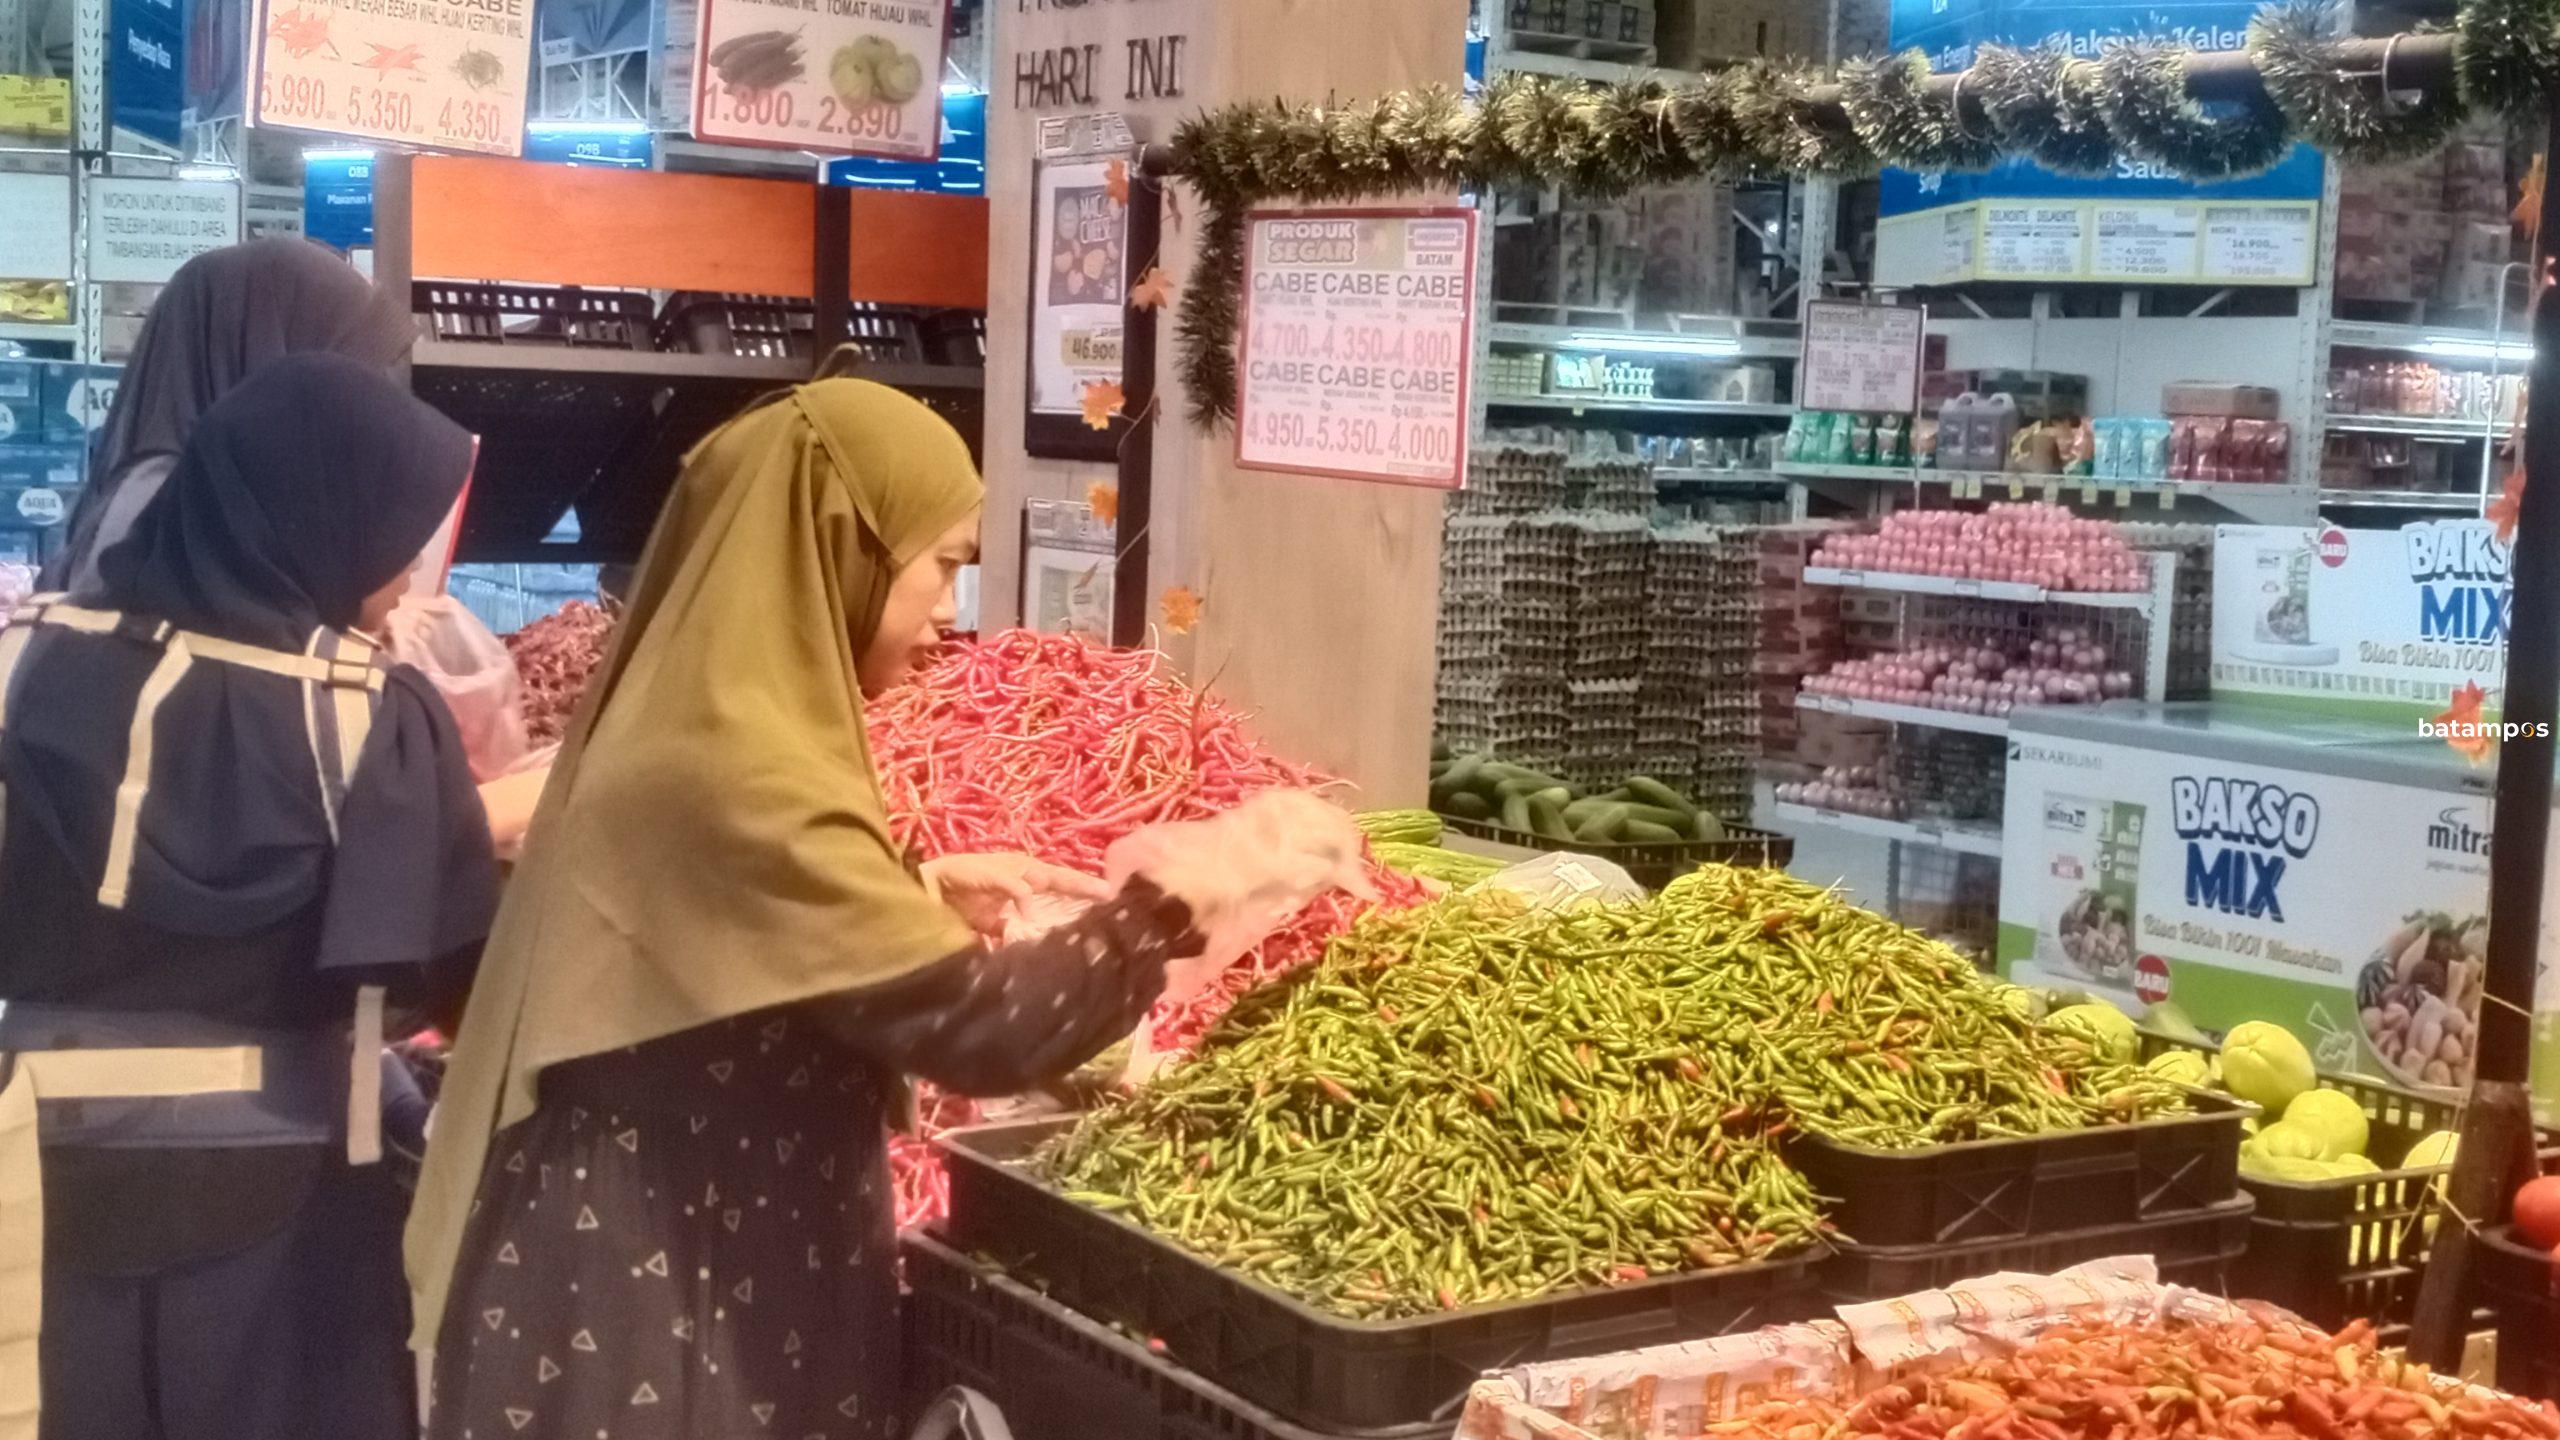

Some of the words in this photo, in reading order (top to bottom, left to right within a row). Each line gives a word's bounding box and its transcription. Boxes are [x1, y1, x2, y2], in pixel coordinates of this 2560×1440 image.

[1015, 44, 1101, 109] HARI
[1125, 35, 1187, 100] INI
[348, 85, 411, 134] 5.350
[438, 97, 501, 143] 4.350
[705, 83, 793, 127] 1.800
[817, 95, 903, 141] 2.890
[1268, 241, 1354, 263] SEGAR
[1269, 222, 1354, 241] PRODUK
[1254, 271, 1317, 294] CABE
[1322, 272, 1390, 296] CABE
[1397, 275, 1464, 298] CABE
[1416, 253, 1453, 266] BATAM
[1252, 322, 1310, 357] 4.700
[1321, 324, 1383, 362] 4.350
[1391, 327, 1452, 368] 4.800
[1250, 360, 1315, 384] CABE
[1318, 364, 1387, 389] CABE
[1389, 369, 1456, 394] CABE
[1247, 411, 1304, 447] 4.950
[1317, 415, 1377, 455] 5.350
[1388, 422, 1449, 462] 4.000
[2420, 584, 2511, 645] MIX
[2171, 775, 2320, 860] BAKSO
[2185, 841, 2287, 923] MIX
